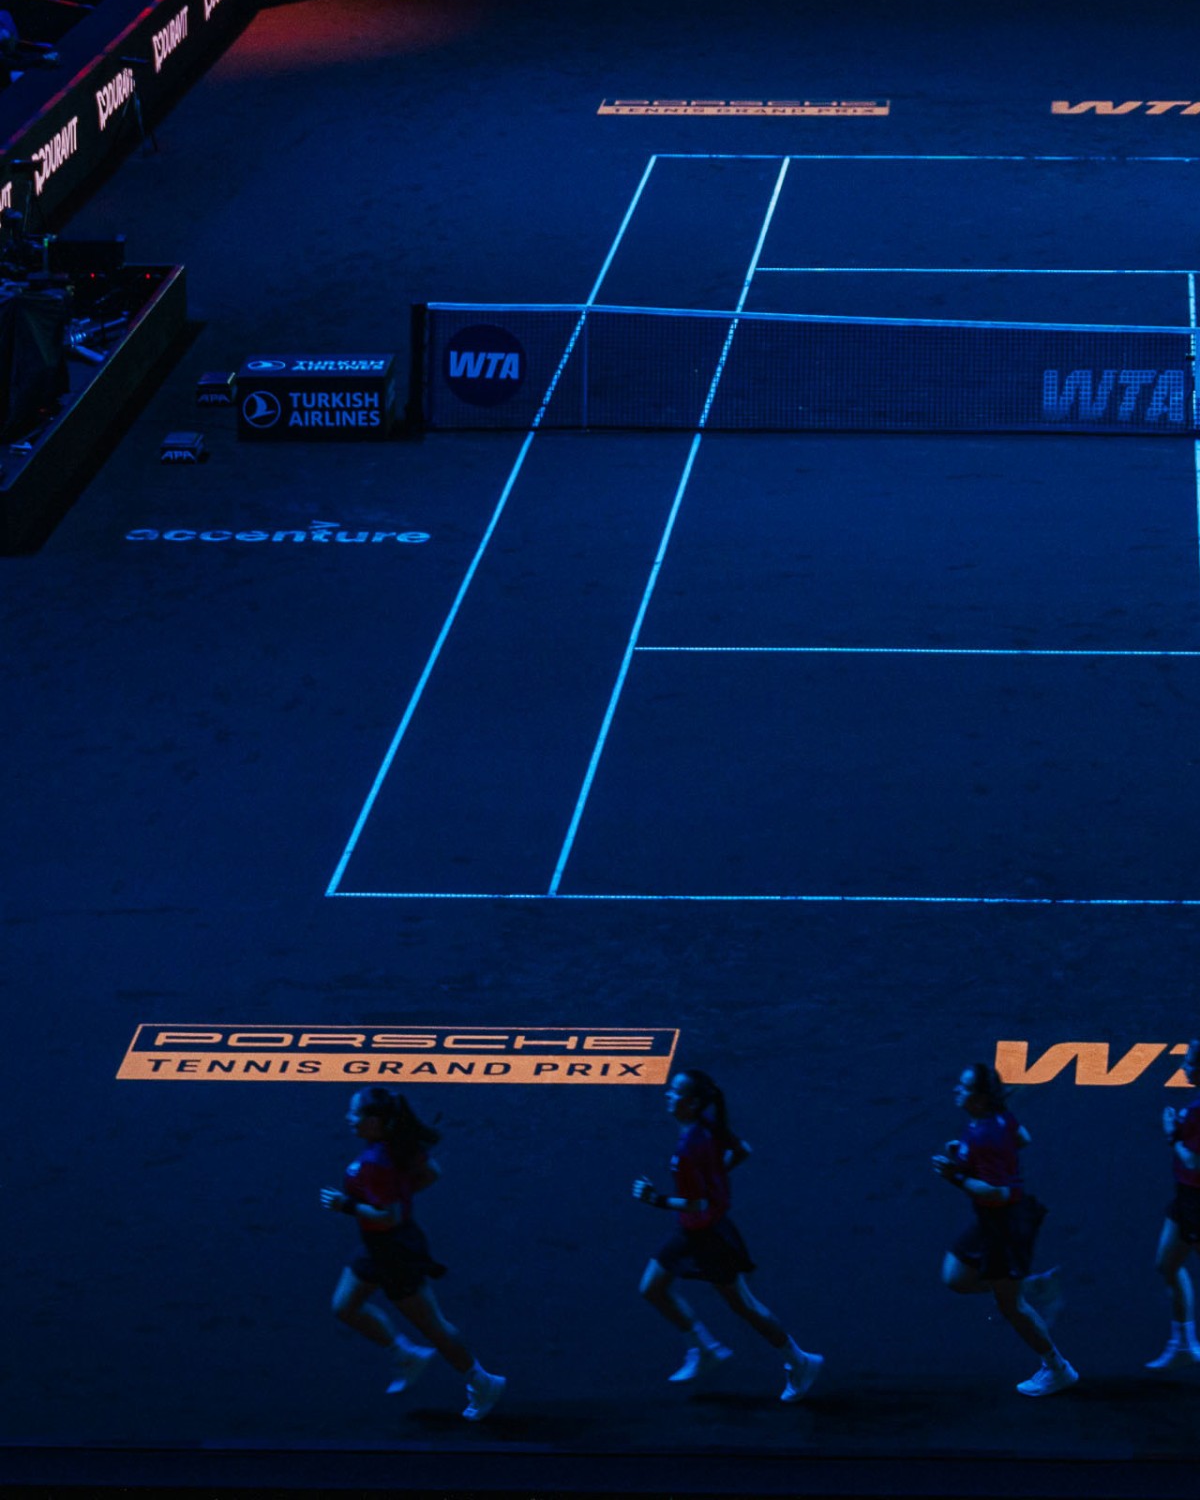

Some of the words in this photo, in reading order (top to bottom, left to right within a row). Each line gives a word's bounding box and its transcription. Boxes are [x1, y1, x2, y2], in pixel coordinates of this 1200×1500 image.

[448, 350, 520, 380] WTA
[288, 391, 379, 408] TURKISH
[1043, 368, 1185, 422] WTA
[288, 409, 381, 427] AIRLINES
[161, 451, 196, 461] APA
[124, 525, 432, 544] accenture
[154, 1031, 655, 1051] PORSCHE
[147, 1058, 323, 1075] TENNIS
[342, 1060, 512, 1076] GRAND
[533, 1062, 645, 1077] PRIX
